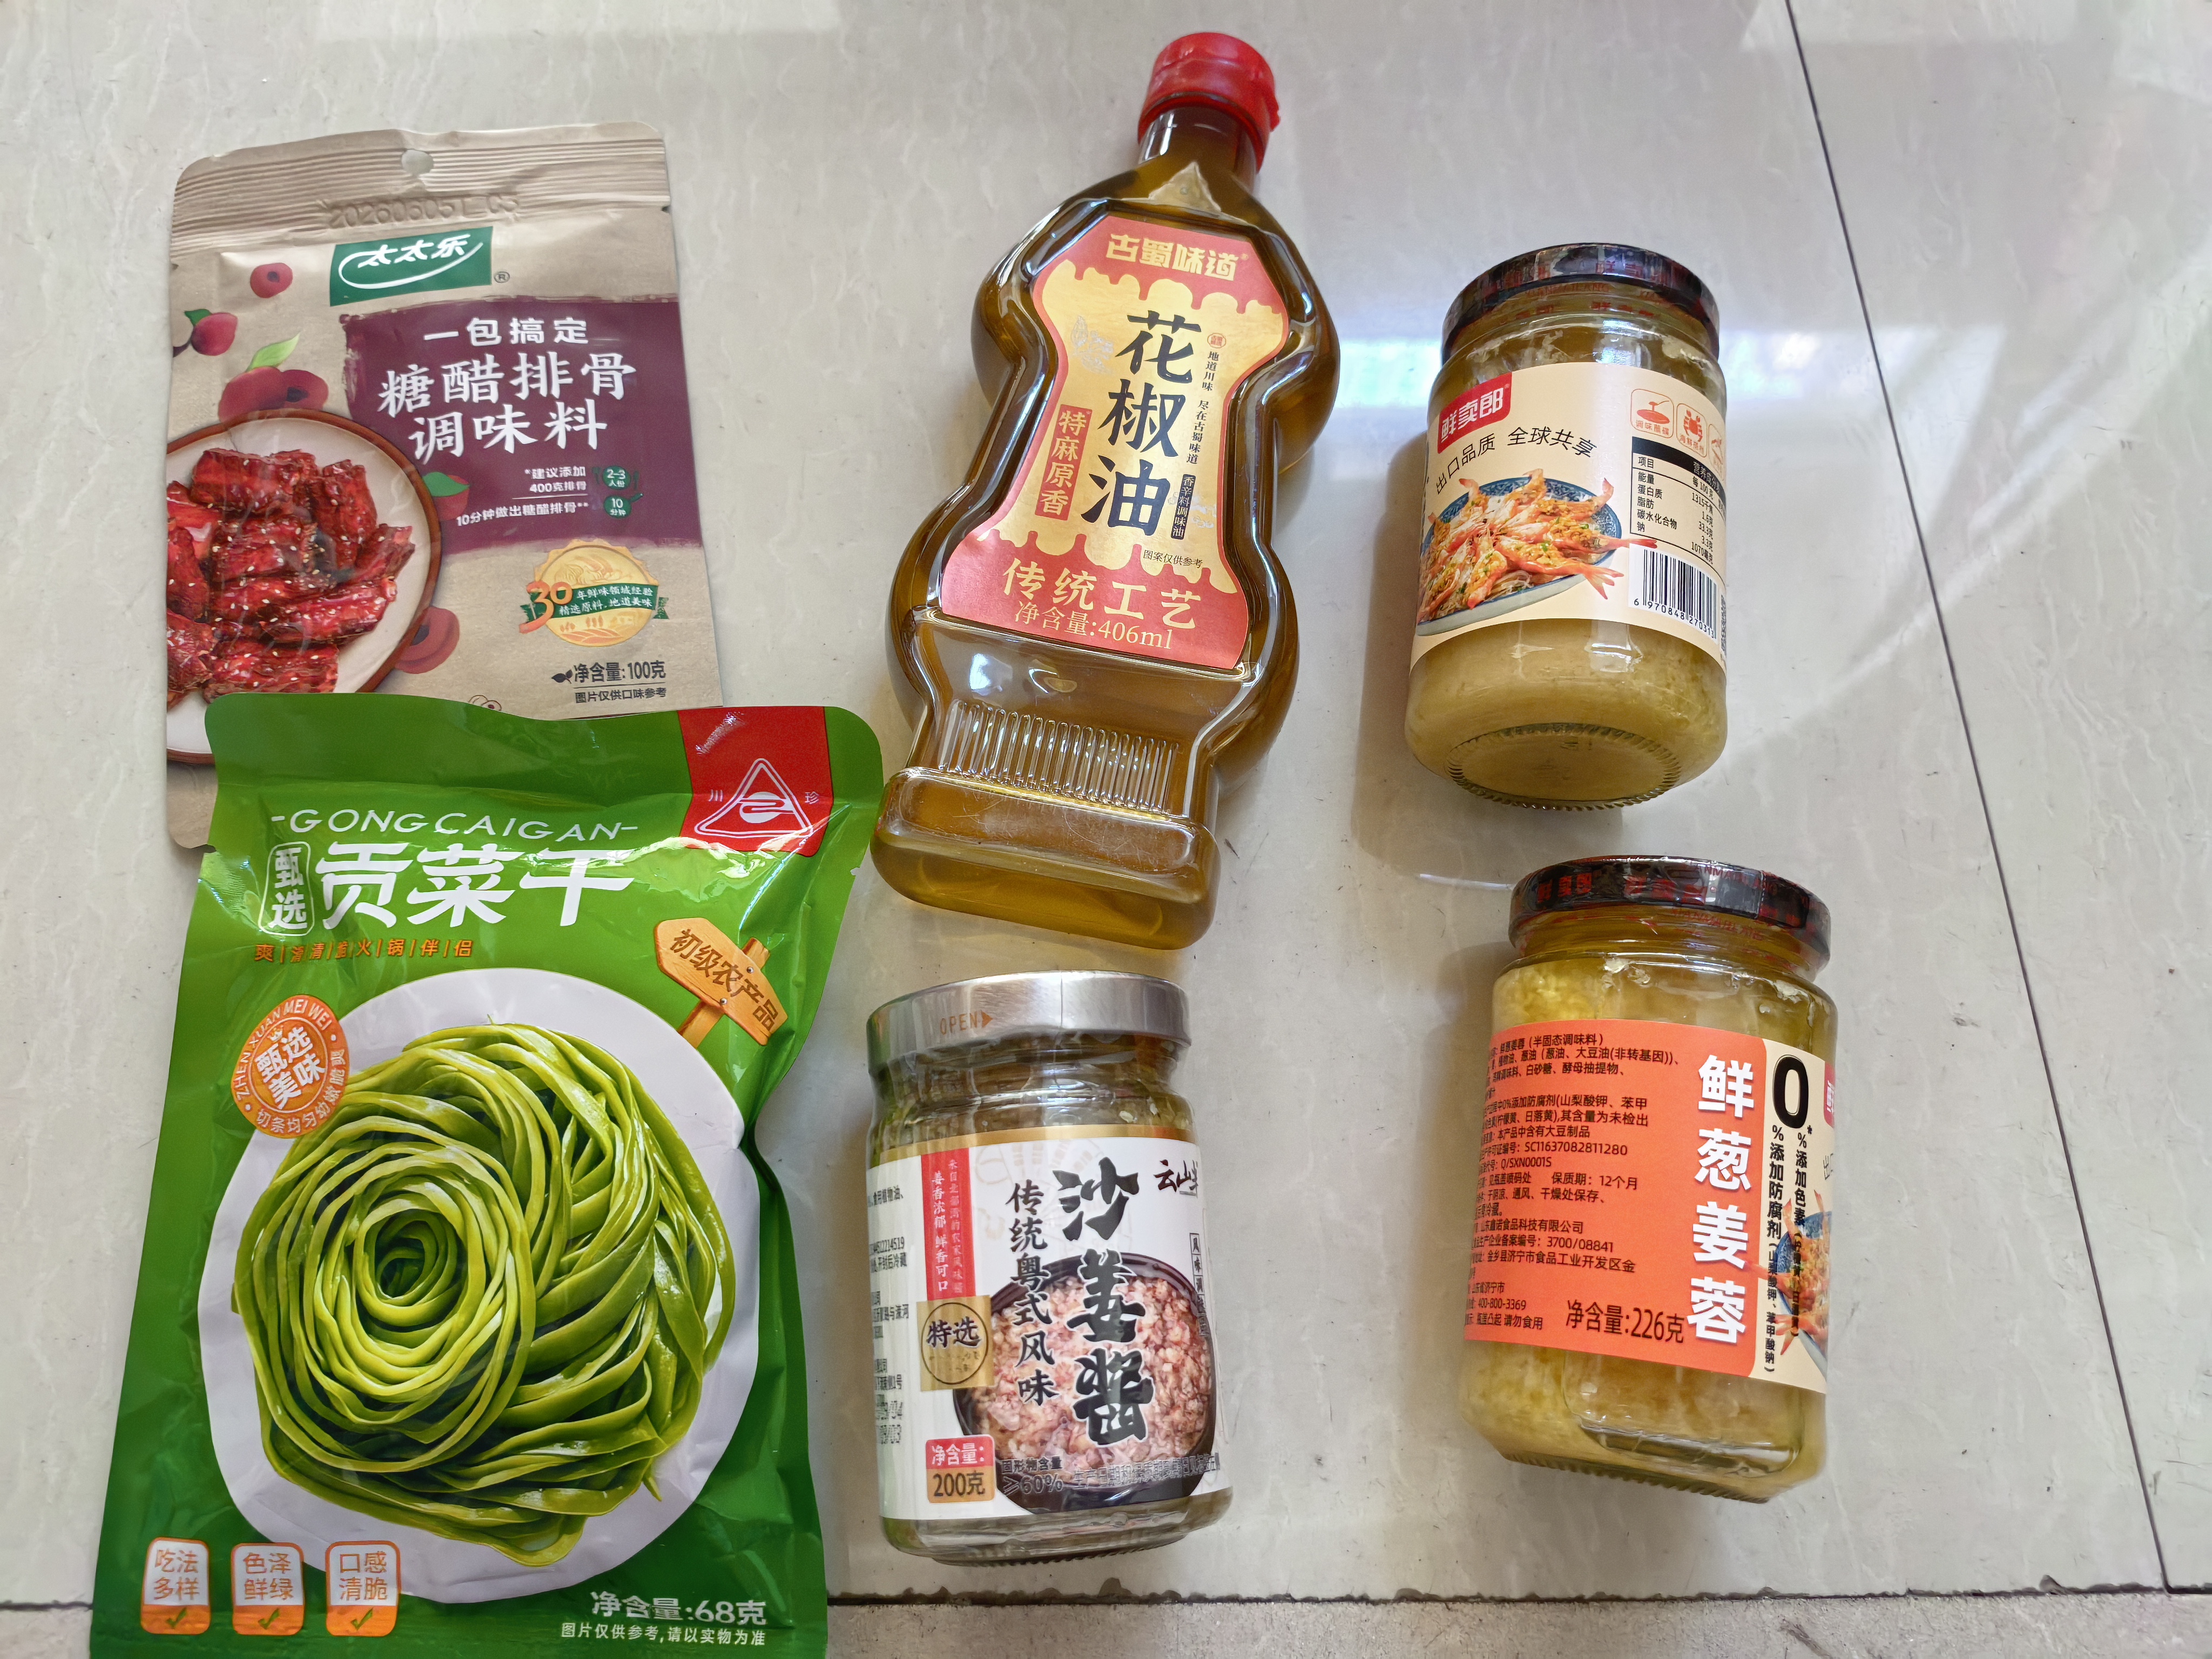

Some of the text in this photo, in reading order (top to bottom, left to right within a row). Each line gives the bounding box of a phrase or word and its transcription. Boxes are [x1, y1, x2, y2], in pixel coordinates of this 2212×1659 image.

[356, 233, 471, 268] 太太乐
[1105, 233, 1240, 281] 古蜀味道
[423, 317, 590, 347] 一包搞定
[377, 350, 636, 418] 糖醋排骨
[1202, 351, 1219, 392] 地道川味
[1081, 310, 1202, 536] 花椒油
[1441, 387, 1504, 443] 鲜卖郎
[409, 397, 608, 466] 调味料
[1186, 400, 1209, 465] 尽在古蜀味道
[1040, 410, 1088, 516] 特麻原香
[1435, 426, 1598, 495] 出口品质 全球共享
[1638, 456, 1654, 469] 项目
[529, 481, 587, 494] 400克排骨
[1638, 471, 1655, 484] 能量
[611, 497, 624, 508] 10
[1637, 484, 1663, 500] 蛋白质
[1637, 496, 1655, 509] 脂肪
[1172, 476, 1195, 538] 香辛料调味油
[1636, 521, 1714, 565] 钠 1070毫克
[1637, 509, 1714, 552] 碳水化合物 3.3克
[1142, 549, 1203, 569] 图案仅供参考
[1002, 557, 1201, 630] 传统工艺
[519, 581, 573, 635] 30
[575, 687, 667, 704] 图片仅供口味参考
[708, 789, 724, 802] 川
[804, 791, 820, 805] 珍
[272, 847, 308, 930] 甄选
[315, 842, 636, 929] 贡菜干
[669, 928, 779, 1031] 初级农产品
[940, 1010, 978, 1036] OPEN
[1772, 1054, 1809, 1129] 0
[1498, 1124, 1590, 1141] 本产品中含有大豆制品
[1524, 1141, 1628, 1156] SC11637082811280
[1501, 1157, 1552, 1170] Q/SXN0001S
[1599, 1175, 1638, 1191] 12个月
[1687, 1054, 1756, 1345] 鲜葱姜蓉
[931, 1170, 949, 1292] 姜香浓郁 鲜香可口
[1546, 1236, 1614, 1253] 3700/08841
[1486, 1250, 1636, 1273] 金乡县济宁市食品工业开发区金
[1004, 1178, 1059, 1407] 传统粤式风味
[1478, 1297, 1527, 1311] 400-800-3369
[926, 1316, 982, 1348] 特选
[1504, 1313, 1543, 1331] 请勿食用
[1001, 1455, 1063, 1474] 固形物含量
[933, 1469, 986, 1497] 200克
[1002, 1472, 1064, 1496] ≥60%
[154, 1549, 199, 1575] 吃法
[242, 1552, 292, 1575] 色泽
[339, 1550, 388, 1574] 口感
[153, 1576, 200, 1601] 多样
[244, 1577, 294, 1601] 鲜绿
[338, 1576, 388, 1602] 清脆
